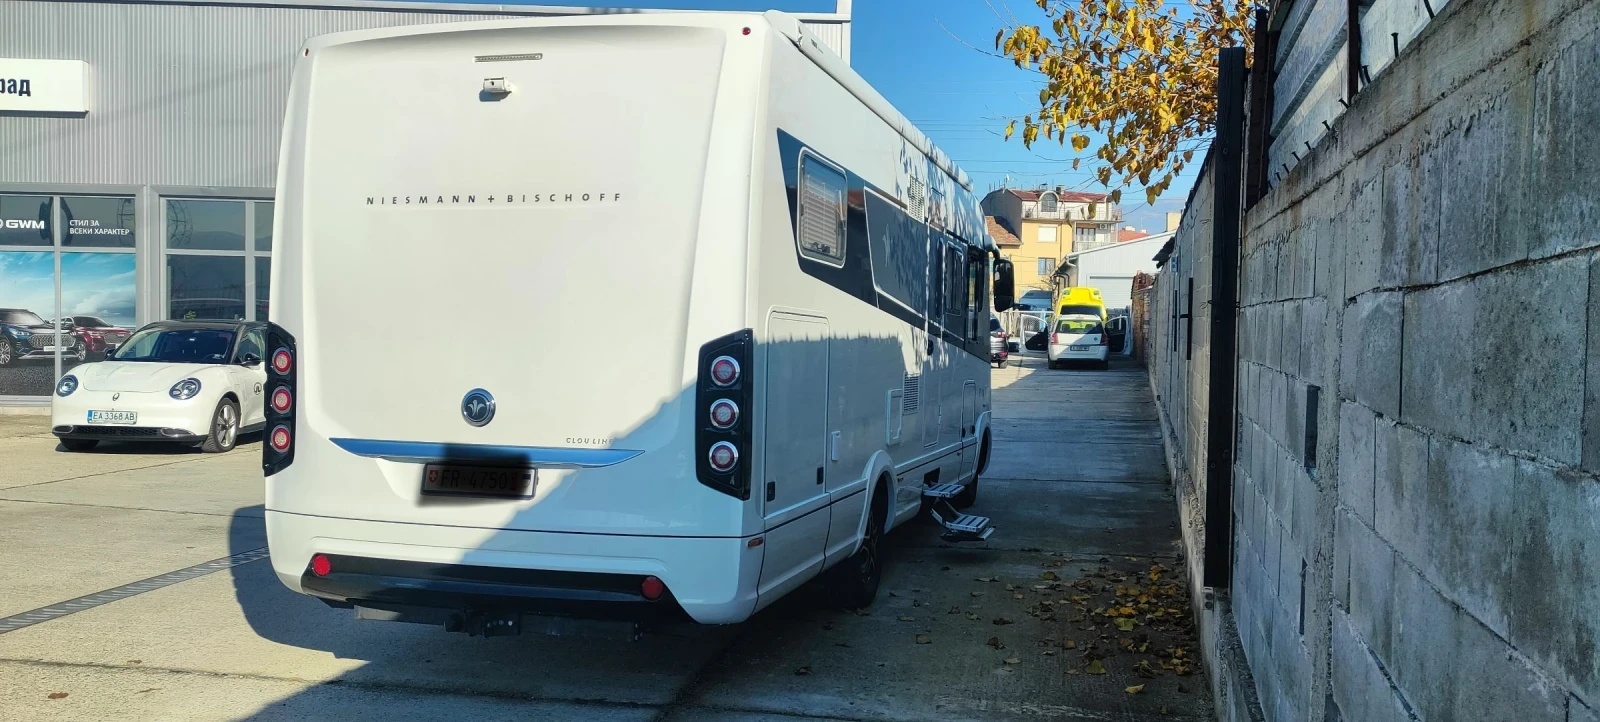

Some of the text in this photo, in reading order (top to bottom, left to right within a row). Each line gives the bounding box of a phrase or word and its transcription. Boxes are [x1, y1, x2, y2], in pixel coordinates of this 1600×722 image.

[366, 195, 476, 205] NIESMANN
[506, 193, 621, 203] BISCHOFF
[6, 219, 45, 229] GWM
[69, 219, 100, 227] СТИЛ ЗА
[94, 228, 130, 236] ХАРАКТЕР
